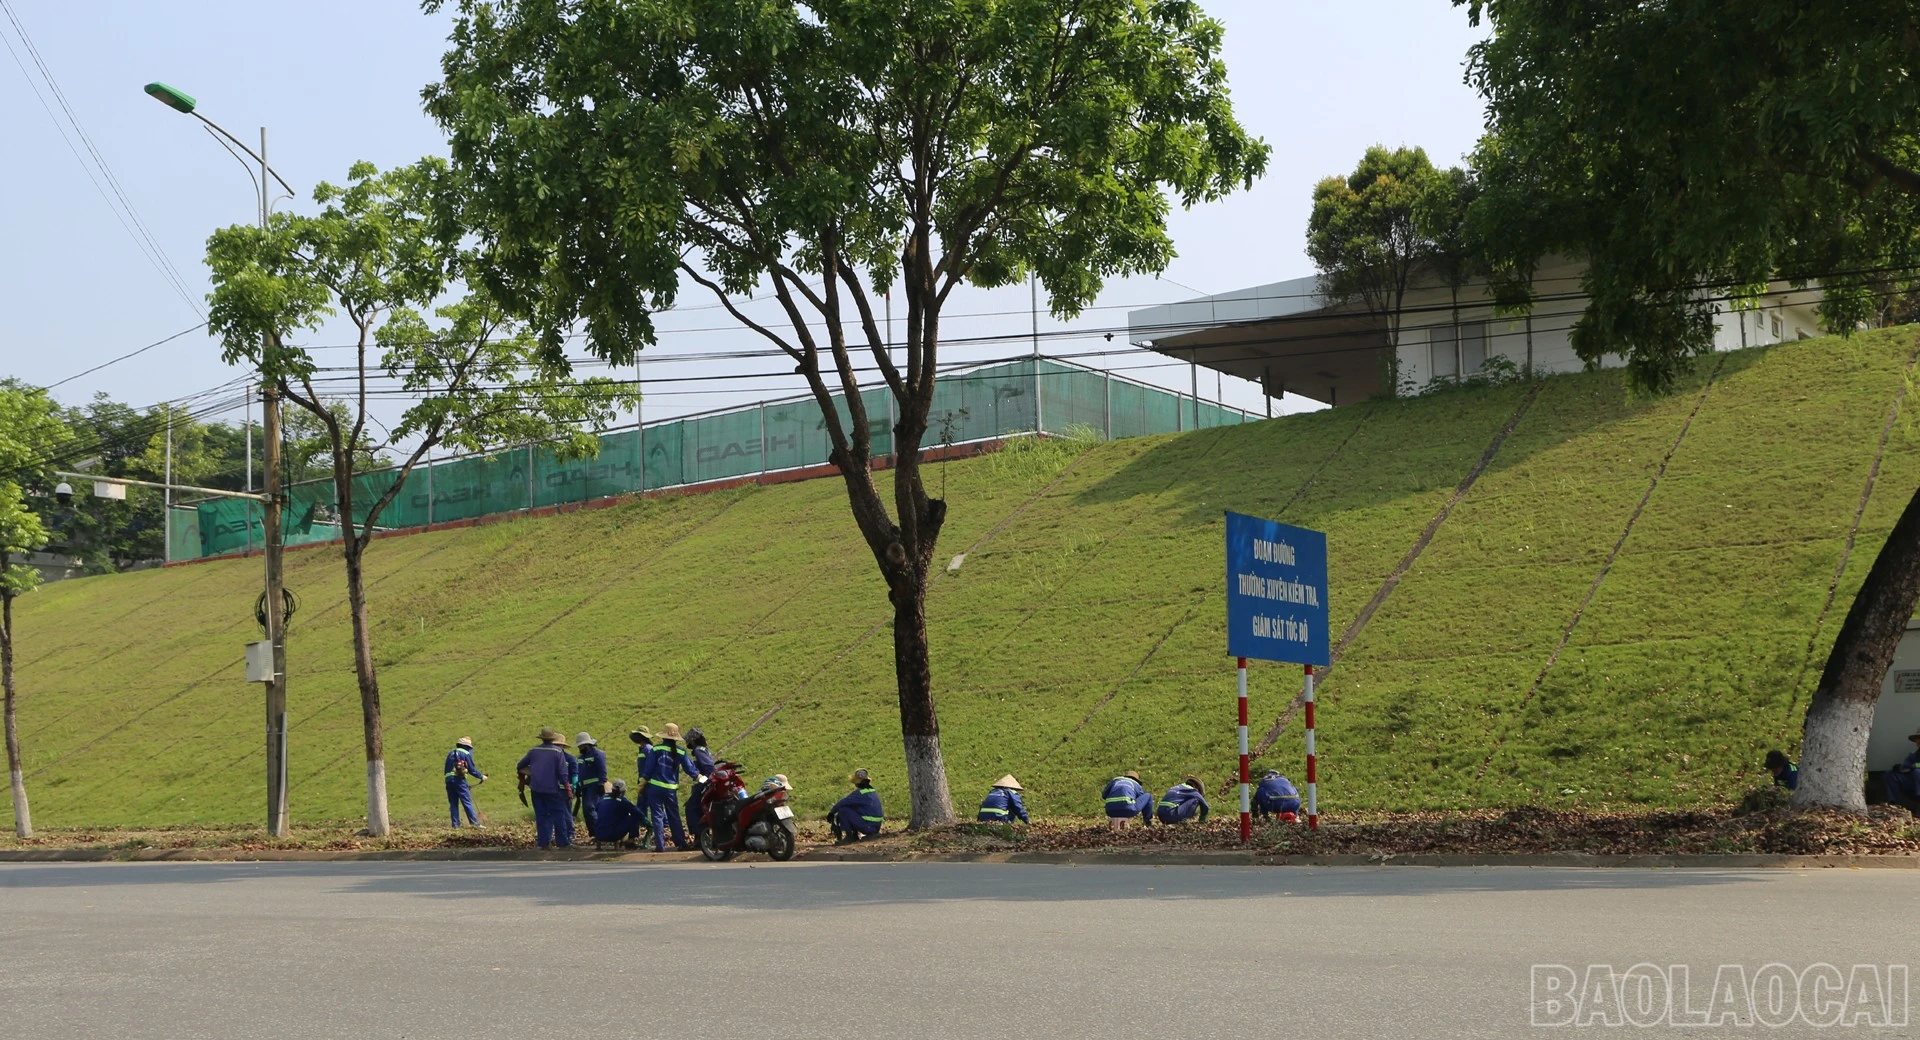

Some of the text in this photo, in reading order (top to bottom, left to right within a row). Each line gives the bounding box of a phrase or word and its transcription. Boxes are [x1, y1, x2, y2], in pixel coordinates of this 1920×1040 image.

[1253, 538, 1296, 566] ĐOẠN ĐƯỜNG
[1238, 570, 1319, 609] THƯỜNG XUYÊN KIỂM TRA,
[1252, 612, 1308, 647] GIÁM SÁT TỐC ĐỘ
